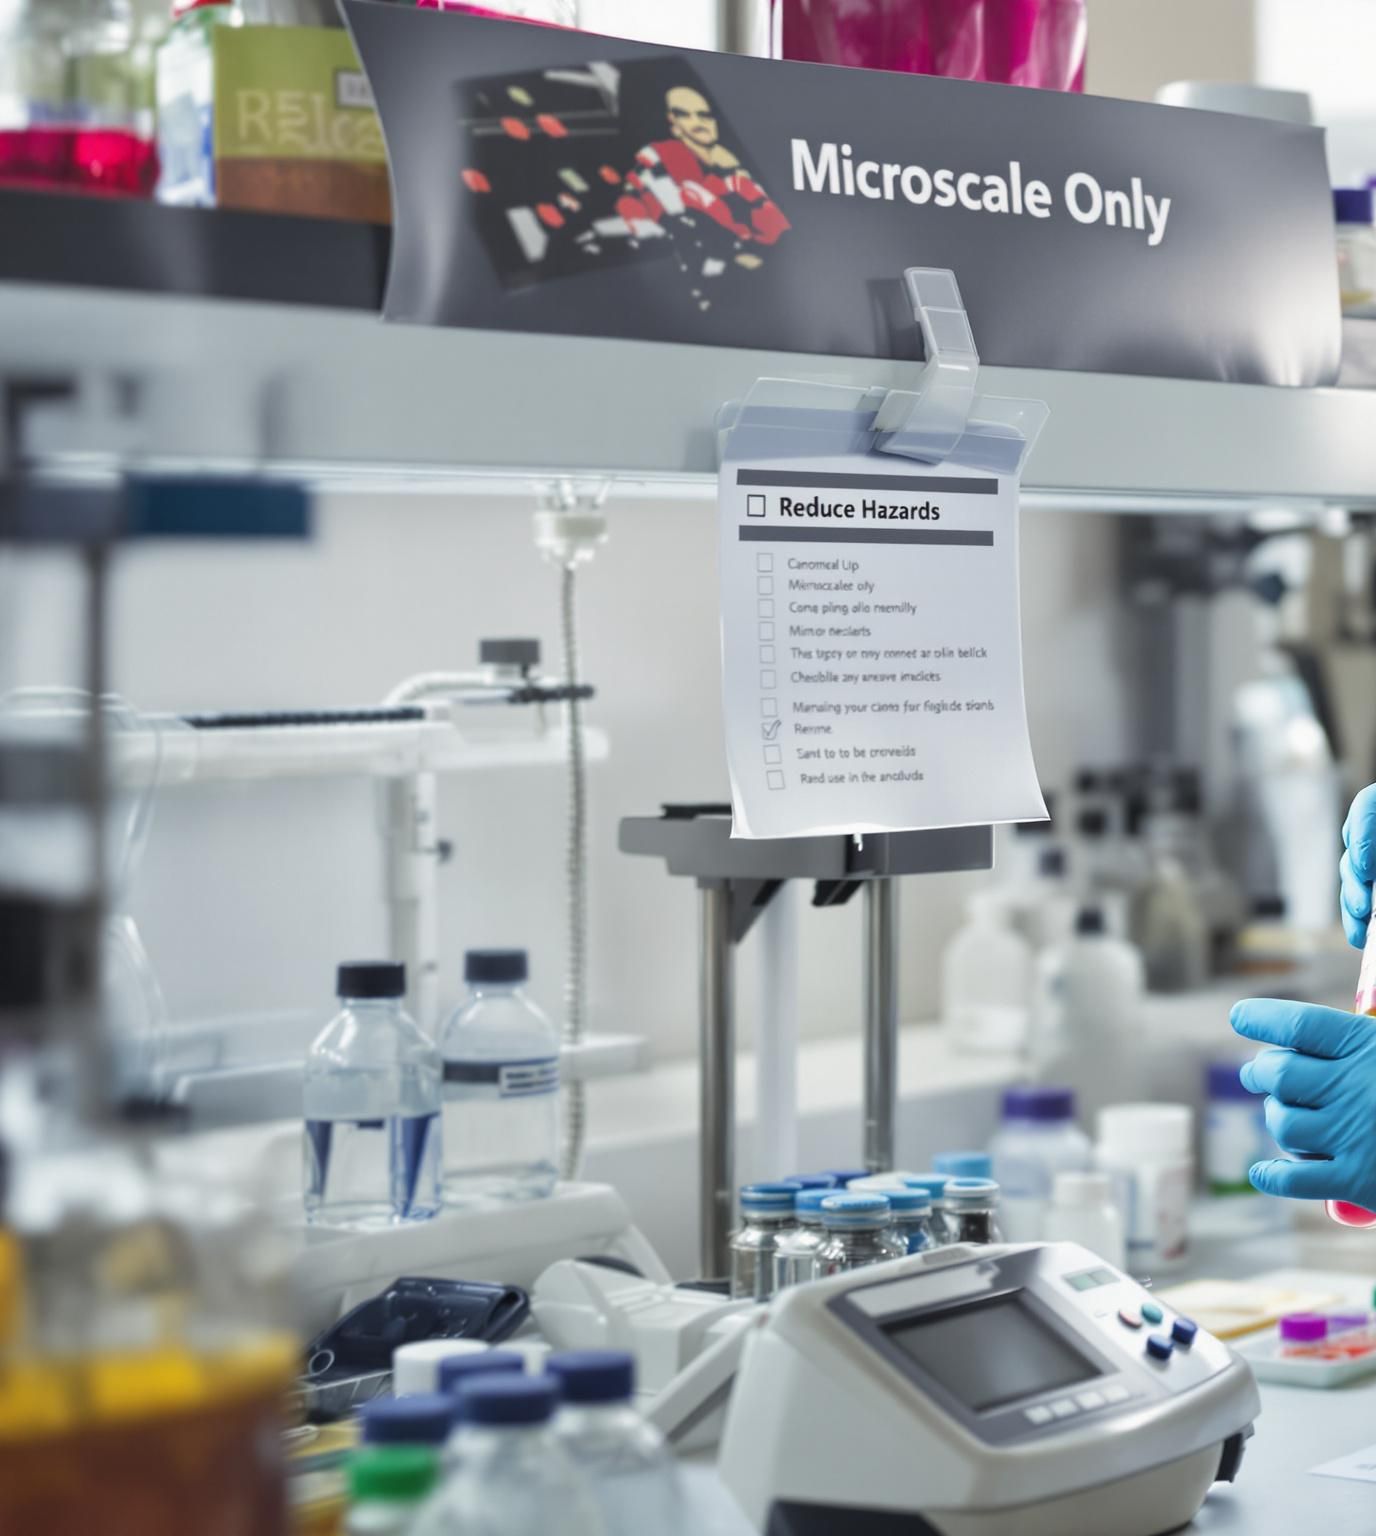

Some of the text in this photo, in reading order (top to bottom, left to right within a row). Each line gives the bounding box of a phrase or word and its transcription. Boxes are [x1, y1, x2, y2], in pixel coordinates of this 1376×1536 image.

[790, 138, 1172, 246] Microscale Only
[779, 496, 941, 521] Reduce Hazards
[852, 746, 866, 758] be
